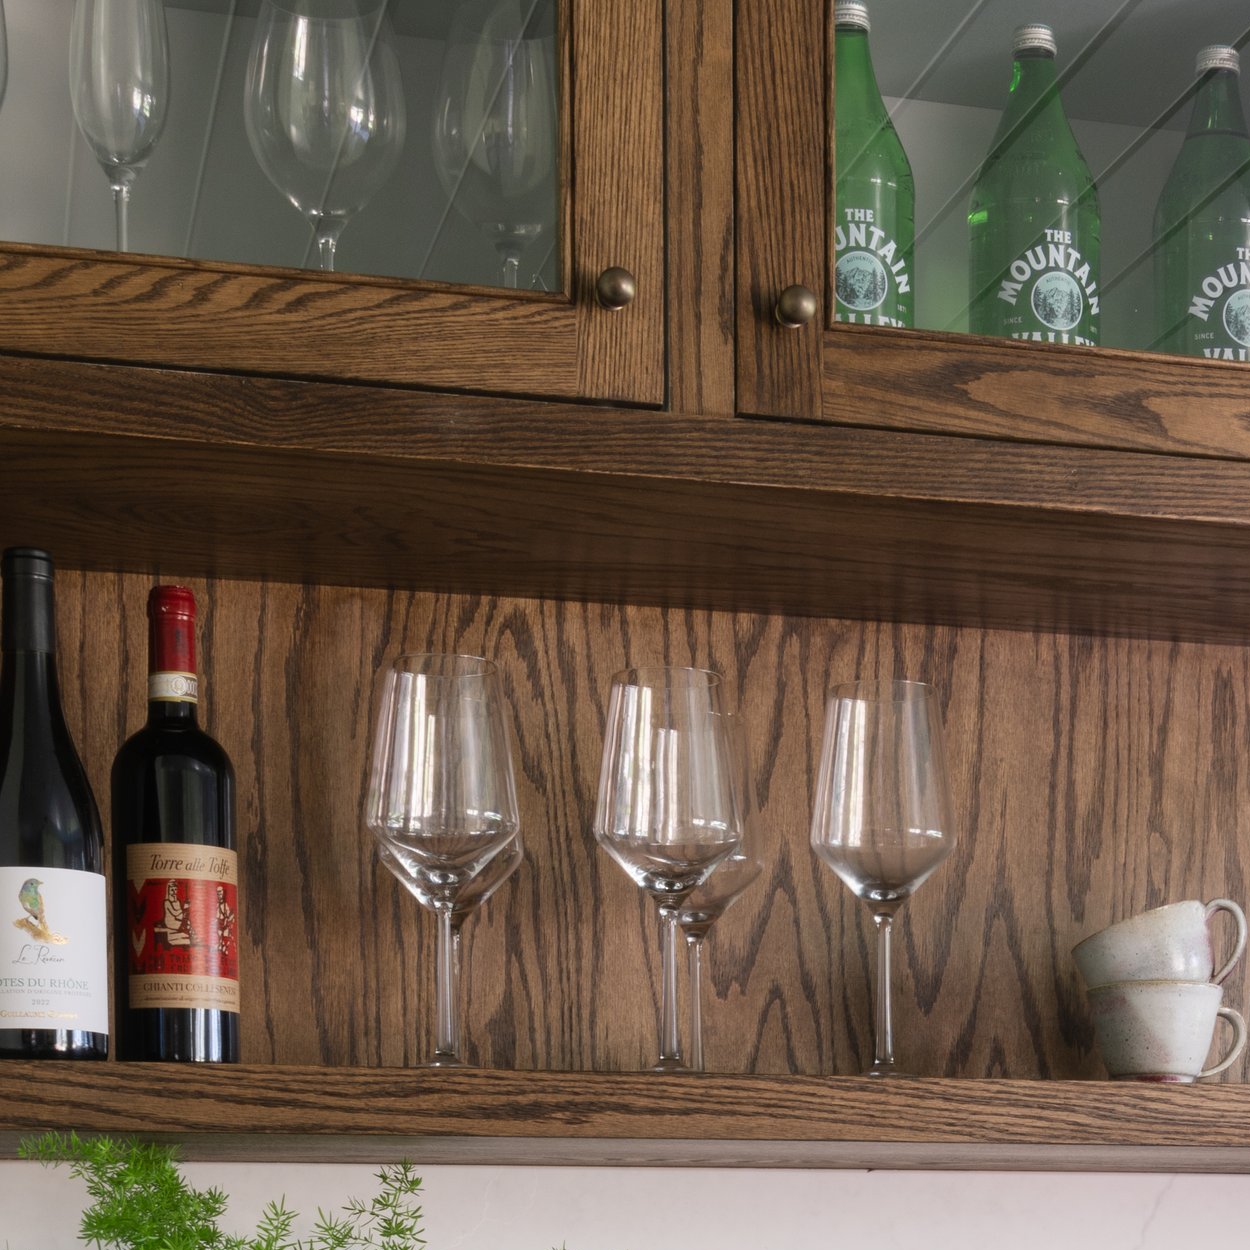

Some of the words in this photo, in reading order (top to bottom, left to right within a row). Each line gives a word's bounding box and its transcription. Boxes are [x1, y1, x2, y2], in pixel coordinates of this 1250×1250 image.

[845, 208, 874, 222] THE
[1045, 229, 1072, 244] THE
[997, 243, 1100, 316] MOUNTAIN
[1194, 332, 1215, 340] SINCE
[150, 854, 183, 871] Torre
[185, 858, 206, 872] alle
[208, 857, 230, 880] Tolfe
[28, 977, 46, 988] DU
[50, 976, 89, 991] RHÔNE
[143, 982, 184, 992] CHIANTI
